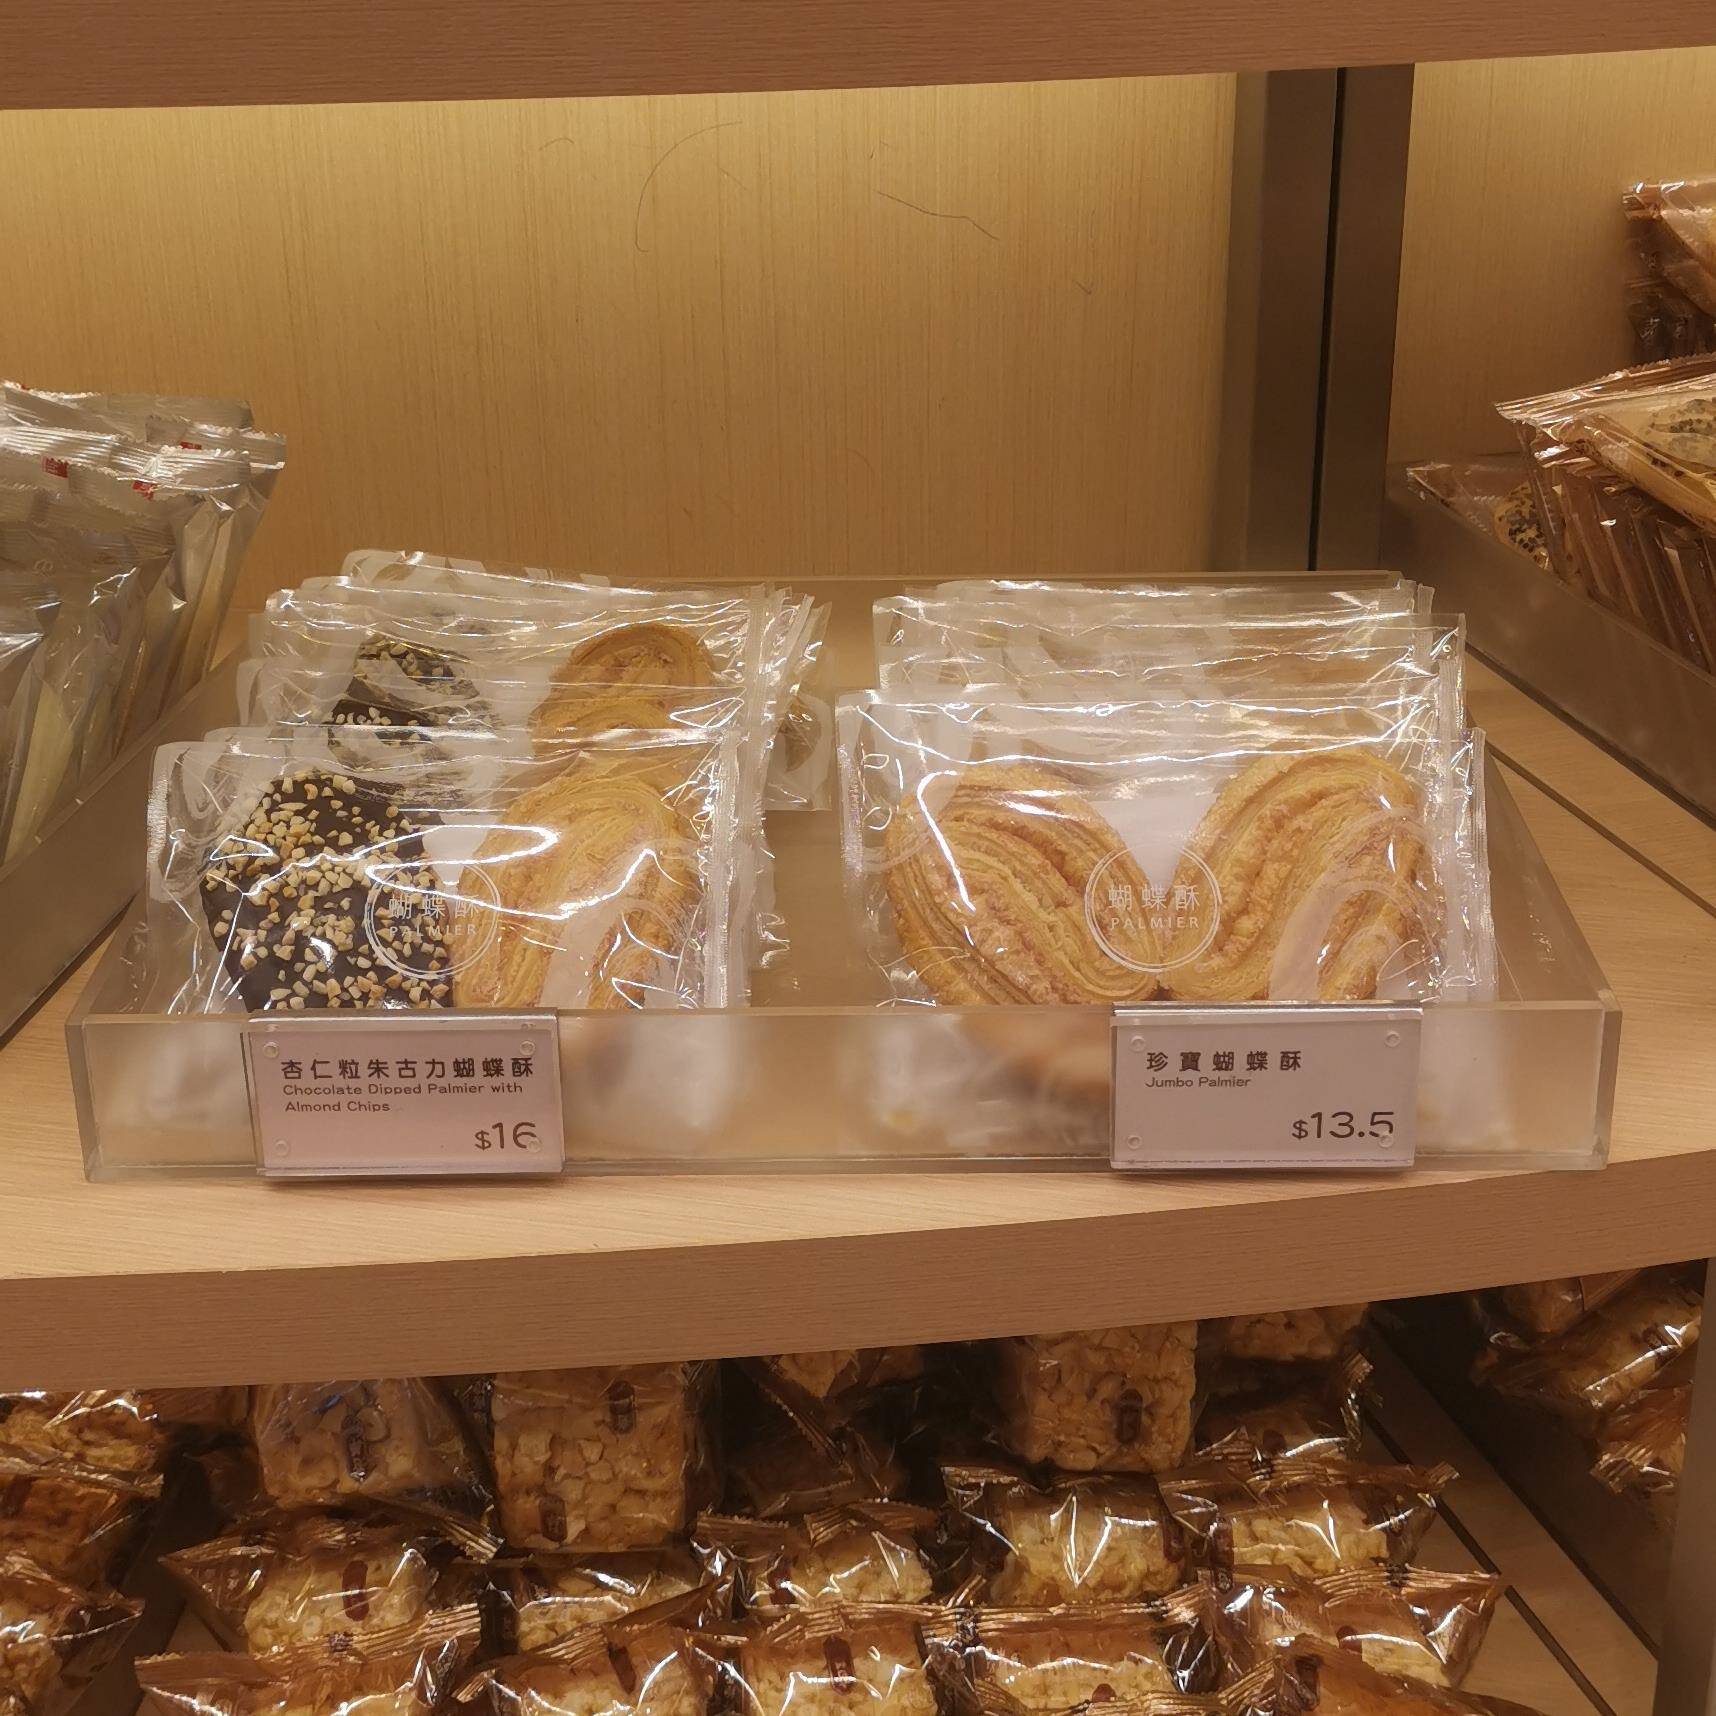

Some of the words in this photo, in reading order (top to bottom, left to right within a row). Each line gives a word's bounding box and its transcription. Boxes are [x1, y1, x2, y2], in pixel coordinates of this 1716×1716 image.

[389, 895, 479, 920] 蝴蝶酥
[1108, 884, 1200, 912] 蝴蝶酥
[390, 924, 477, 936] PALMIER
[1111, 917, 1200, 930] PALMIER
[281, 1058, 533, 1080] 杏仁粒朱古力蝴蝶酥
[1146, 1050, 1301, 1072] 珍寶蝴蝶酥
[283, 1084, 362, 1095] Chocolate
[369, 1083, 421, 1095] Dipped
[428, 1083, 484, 1094] Palmier
[491, 1082, 523, 1093] with
[1145, 1077, 1193, 1088] Jumbo
[1199, 1076, 1251, 1087] Palmier
[285, 1101, 341, 1112] Almond
[347, 1101, 390, 1112] Chips
[475, 1122, 537, 1150] $16
[1292, 1111, 1394, 1139] $13.5
